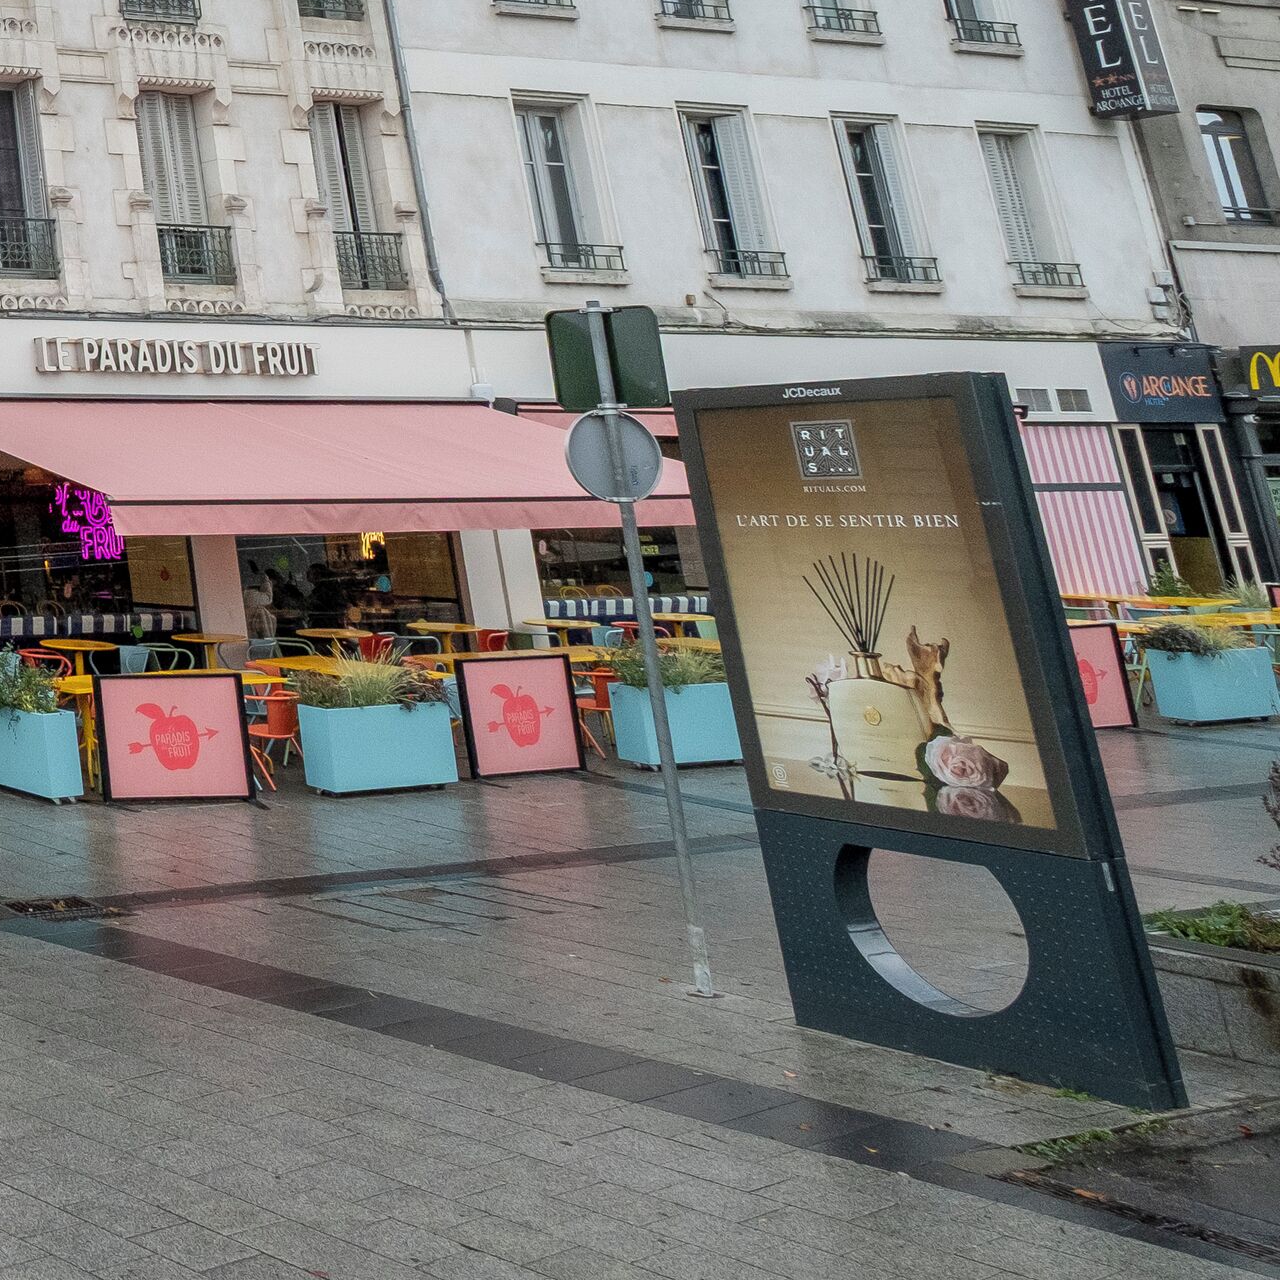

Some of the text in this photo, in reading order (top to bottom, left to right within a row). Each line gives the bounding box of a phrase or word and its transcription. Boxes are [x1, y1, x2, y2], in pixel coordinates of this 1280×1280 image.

[1101, 85, 1134, 99] HOTEL
[40, 337, 321, 376] LE PARADIS DU FRUIT
[782, 387, 842, 399] JCDecaux
[803, 485, 867, 493] RITUALS.COM
[736, 514, 960, 528] L'ART DE SE SENTIR BIEN
[80, 525, 124, 560] FRU
[155, 730, 191, 746] PARADIS
[167, 745, 191, 759] FRUIT
